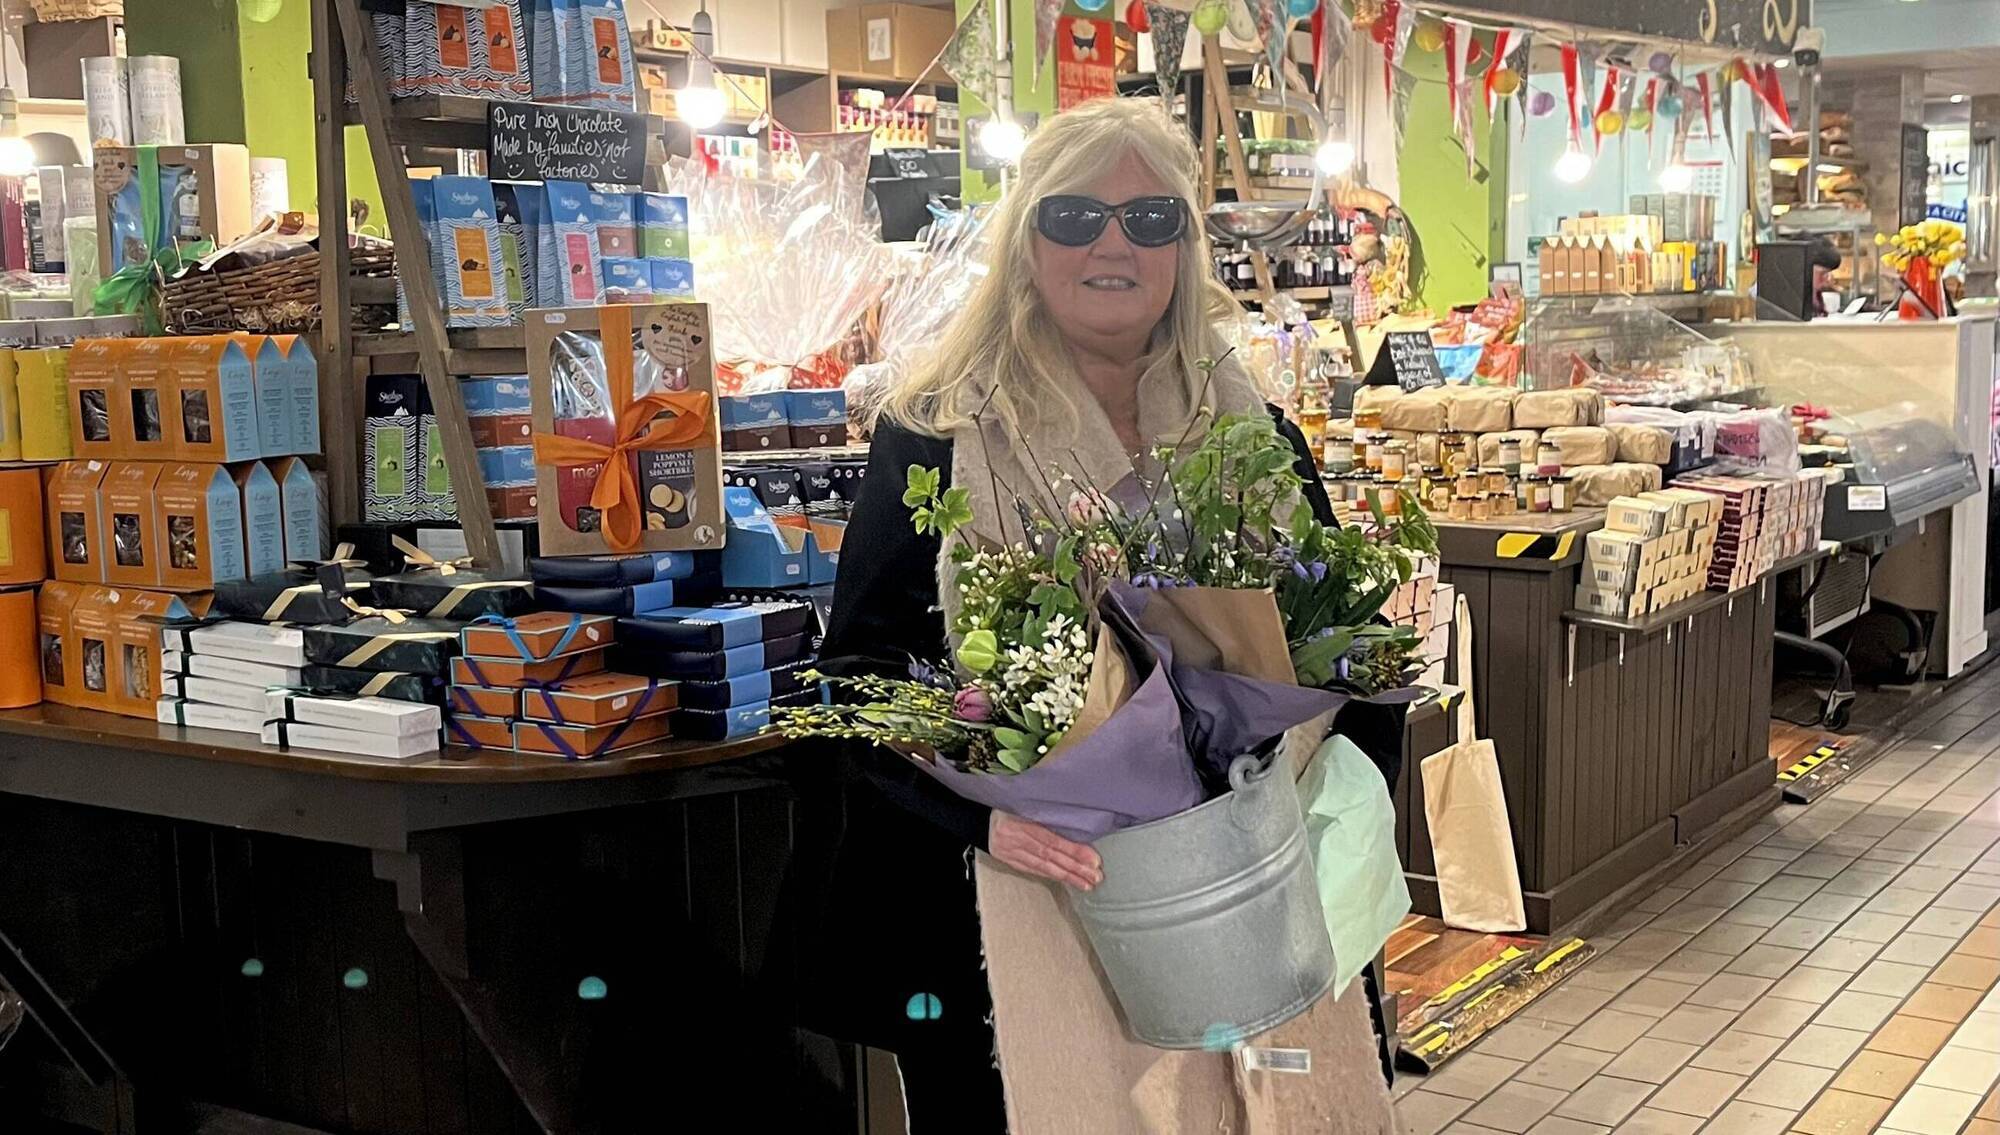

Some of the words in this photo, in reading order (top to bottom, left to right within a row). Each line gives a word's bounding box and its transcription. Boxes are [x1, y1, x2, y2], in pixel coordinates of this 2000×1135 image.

[494, 106, 527, 130] Pure
[535, 110, 562, 133] Irish
[494, 133, 523, 163] Made
[527, 132, 543, 168] by
[655, 452, 686, 462] LEMON
[648, 467, 694, 477] SHORTBRE
